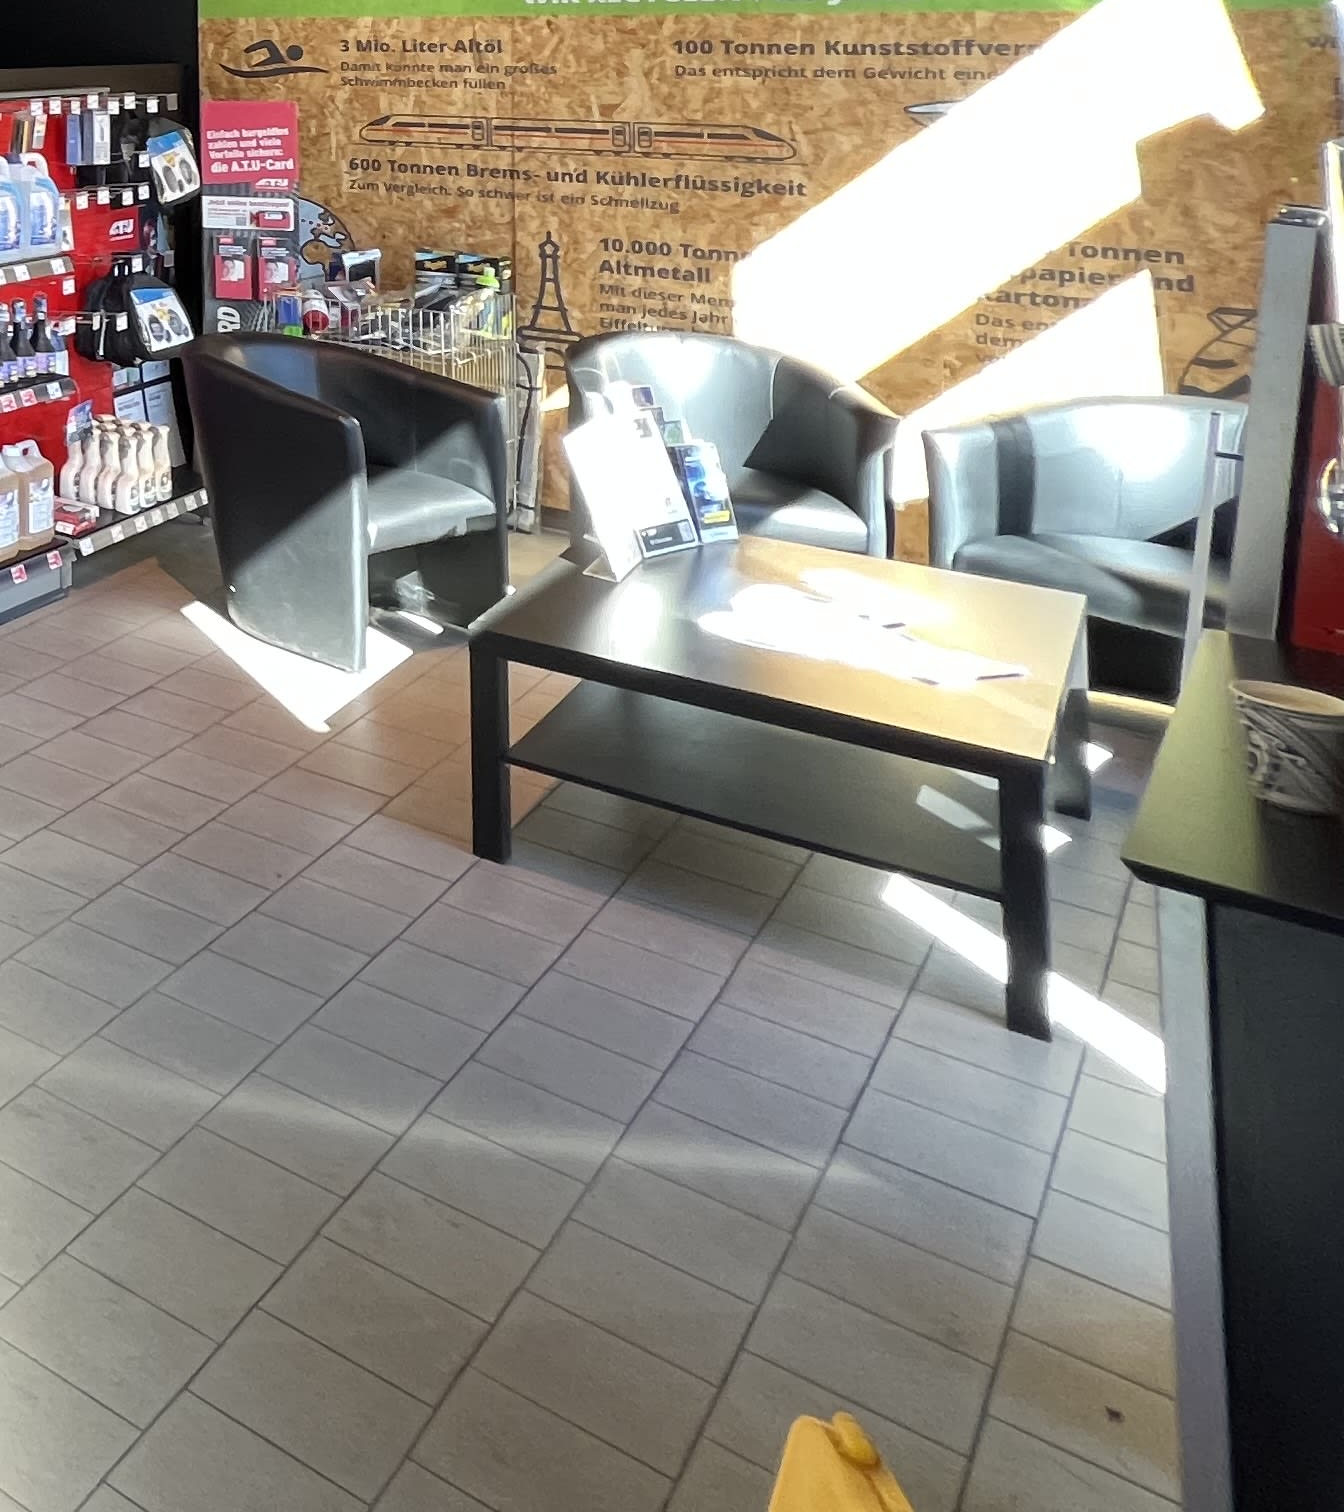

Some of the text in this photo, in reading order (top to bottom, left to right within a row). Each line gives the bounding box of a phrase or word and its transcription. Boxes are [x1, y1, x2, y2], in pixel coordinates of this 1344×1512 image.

[339, 38, 503, 54] 3 Mio. Liter Altöl
[672, 38, 1034, 58] 100 Tonnen Kunststoffver
[340, 61, 381, 73] Damit
[439, 63, 472, 74] man
[476, 62, 500, 74] ein
[674, 64, 707, 78] Das
[711, 65, 808, 83] entspricht
[813, 65, 857, 79] dem
[863, 66, 945, 81] Gewicht
[340, 75, 458, 89] Schwimmbecken
[210, 157, 295, 174] die A.T.U-Card
[348, 157, 808, 198] 600 Tonnen Brems- und Kühlerflüssigkeit
[348, 179, 379, 191] Zum
[456, 185, 474, 198] So
[478, 187, 531, 202] schwer
[536, 191, 555, 204] ist
[560, 195, 586, 207] ein
[591, 194, 681, 215] Schnellzug
[599, 237, 672, 257] 10.000
[599, 259, 711, 284] Altmetall
[1152, 274, 1196, 294] nd
[599, 283, 736, 308] Mit dieser Men
[599, 302, 729, 325] man jedes Jahr
[975, 312, 1017, 329] Das
